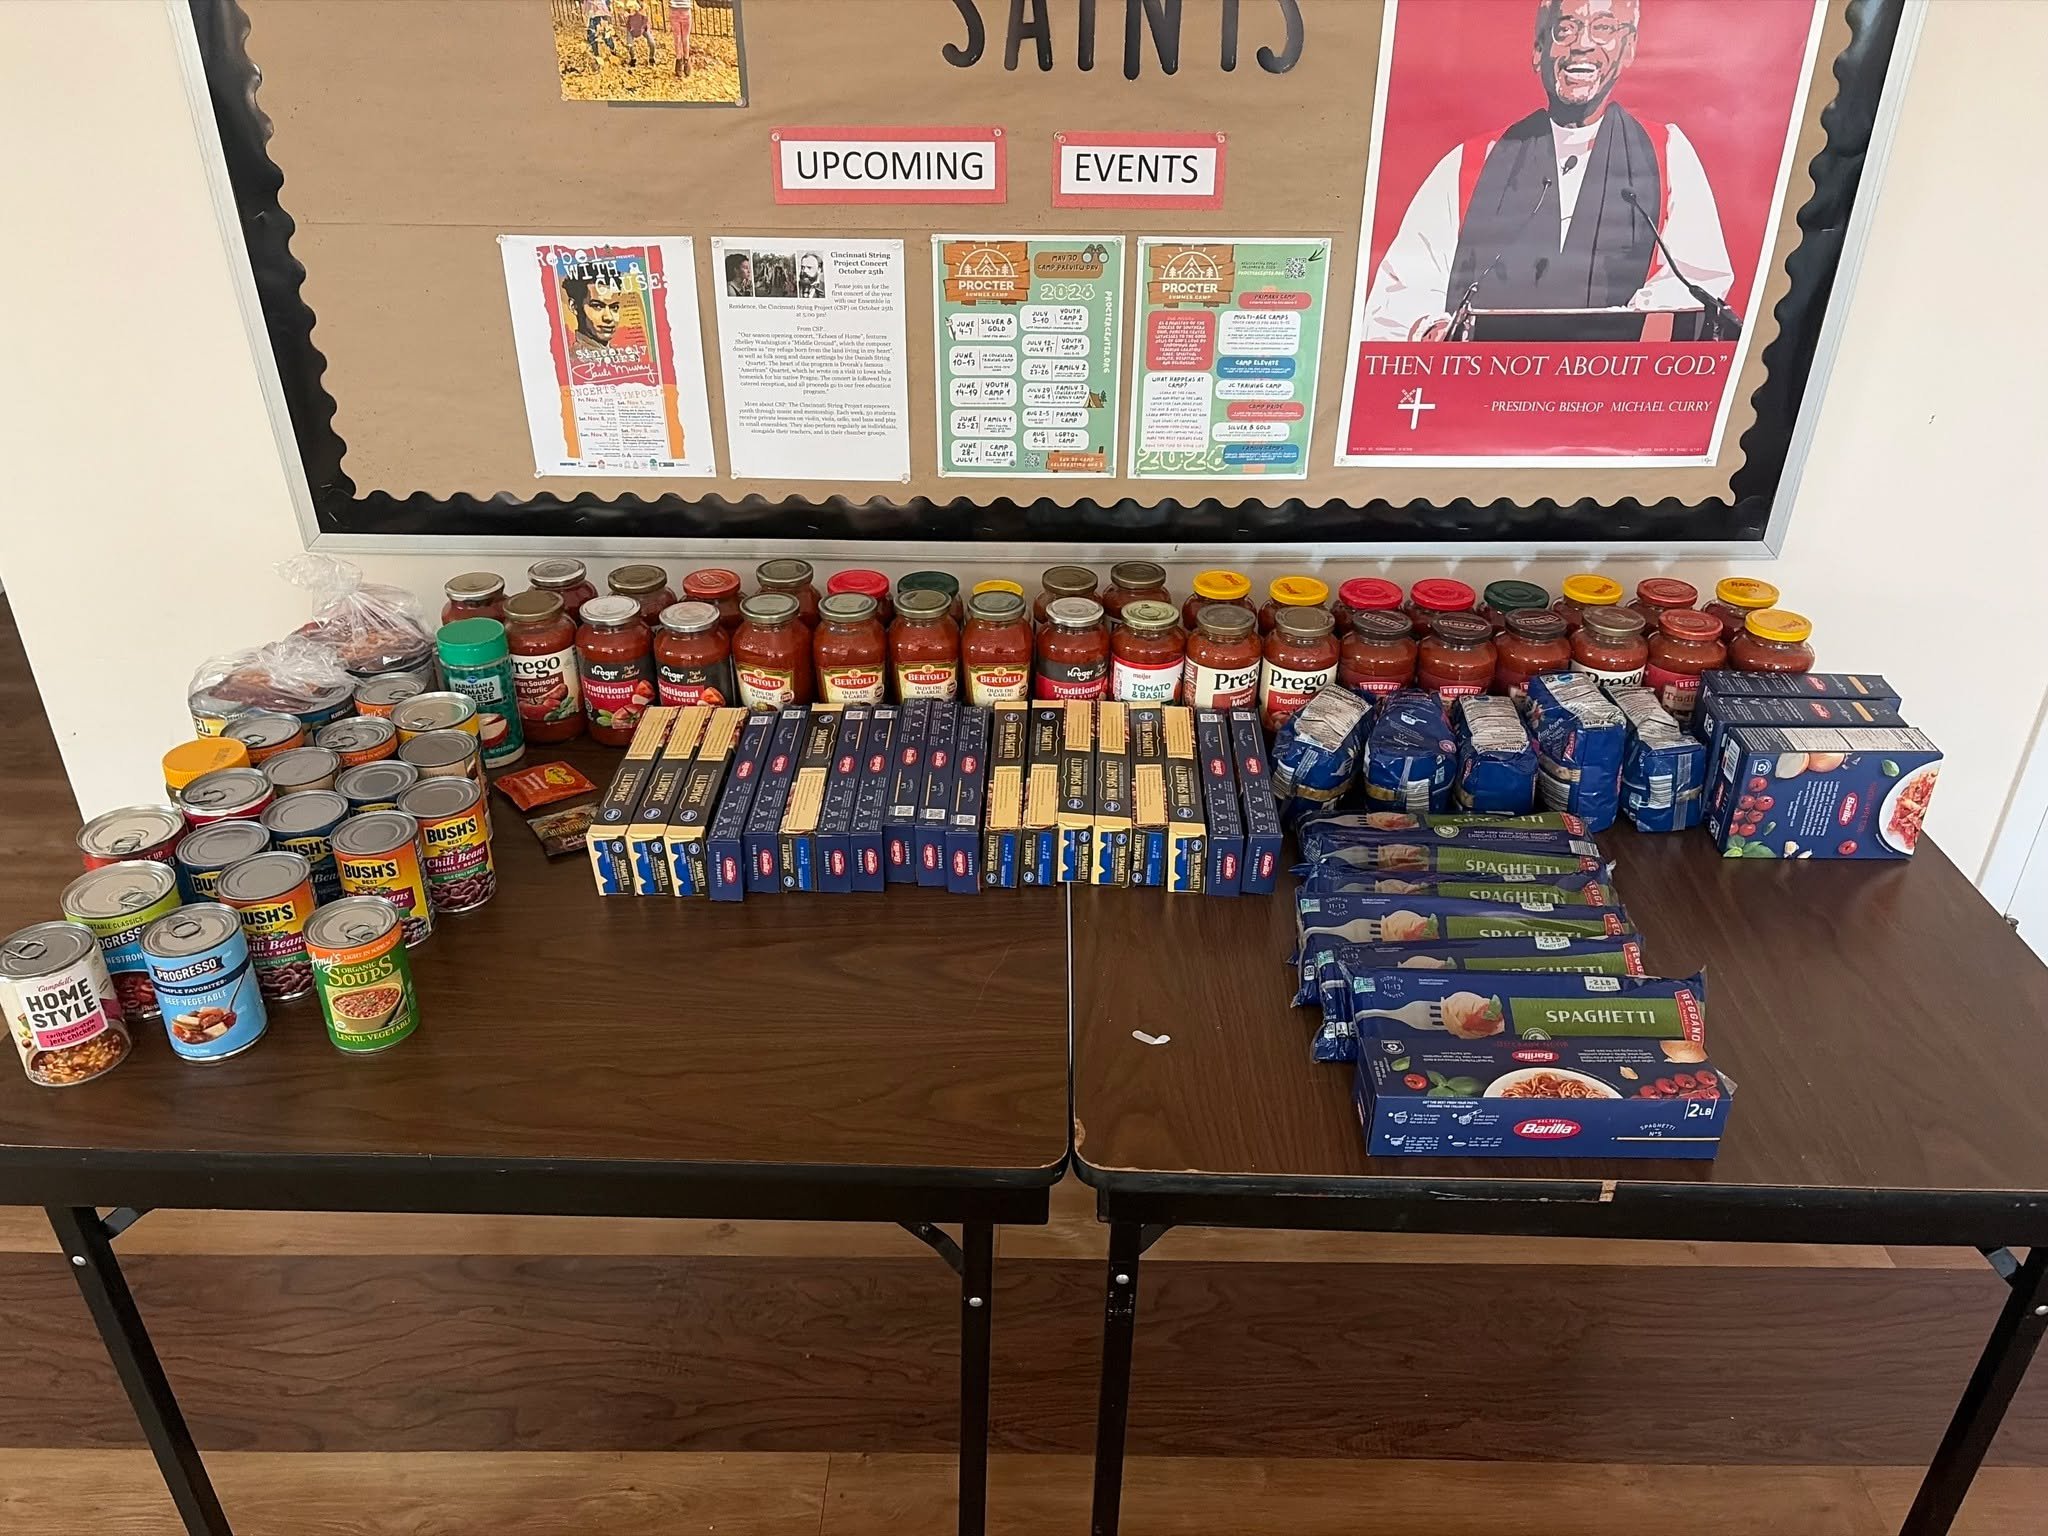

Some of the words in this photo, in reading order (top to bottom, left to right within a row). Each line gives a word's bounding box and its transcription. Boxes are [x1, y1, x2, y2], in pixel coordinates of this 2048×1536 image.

[797, 151, 984, 182] UPCOMING
[1075, 154, 1198, 184] EVENTS
[869, 252, 891, 260] String
[564, 260, 619, 281] WITH
[958, 280, 1014, 291] PROCTER
[1040, 284, 1095, 300] 2026
[1162, 282, 1218, 293] PROCTER
[956, 320, 975, 328] JUNE
[1103, 291, 1113, 373] PROCTERCENTER.ORG
[1365, 355, 1431, 376] THEN
[1441, 355, 1481, 376] IT'S
[1489, 355, 1550, 376] NOT
[1554, 355, 1648, 377] ABOUT
[562, 386, 617, 398] CONCERTS
[1491, 401, 1555, 413] PRESIDING
[1559, 401, 1604, 413] BISHOP
[1610, 401, 1665, 413] MICHAEL
[1668, 401, 1713, 413] CURRY
[511, 656, 560, 678] rego
[591, 665, 618, 681] Kroger
[661, 666, 685, 682] Kroger
[1067, 667, 1093, 681] Kroger
[528, 676, 559, 687] Sausage
[743, 674, 781, 687] BERTOLLI
[833, 676, 876, 688] BERTOLLI
[907, 671, 950, 683] BERTOLLI
[979, 674, 1022, 686] BERTOLLI
[1132, 672, 1151, 680] meijer
[1270, 668, 1327, 695] Prego
[526, 686, 548, 694] Garlic
[584, 681, 634, 694] Traditional
[1132, 682, 1171, 693] TOMATO
[1132, 691, 1139, 699] &
[1140, 691, 1164, 700] BASIL
[1443, 687, 1479, 695] REGGANO
[1070, 759, 1082, 784] SPAGHETTI
[1106, 761, 1117, 787] SPAGHETTI
[613, 773, 636, 802] SPAGHETTI
[652, 772, 674, 801] SPAGHETTI
[688, 774, 709, 803] SPAGHETTI
[1840, 797, 1856, 822] Barilla
[426, 818, 476, 845] BUSH'S
[427, 855, 454, 868] Chili
[458, 846, 485, 862] Beans
[436, 865, 460, 873] KIDNEY
[463, 857, 482, 867] BEANS
[343, 862, 397, 880] BUSH'S
[1466, 860, 1560, 874] SPAGHETTI
[113, 917, 144, 928] CLASSICS
[311, 951, 342, 972] Amy's
[341, 961, 376, 973] ORGANIC
[157, 959, 216, 982] PROGRESSO
[329, 955, 393, 986] SOUPS
[38, 976, 73, 992] Campbell's
[160, 986, 184, 994] SIMPLE
[184, 980, 225, 994] FAVORITES
[26, 978, 91, 1012] HOME
[164, 996, 180, 1005] BEEF
[181, 990, 227, 1006] VEGETABLE
[32, 995, 97, 1028] STYLE
[1546, 1010, 1656, 1024] SPAGHETTI
[1681, 993, 1701, 1042] REGGANO
[46, 1019, 95, 1039] caribbean-style
[50, 1035, 67, 1046] jerk
[68, 1023, 96, 1041] chicken
[336, 1031, 365, 1042] LENTIL
[367, 1017, 411, 1040] VEGETABLE
[1518, 1052, 1553, 1060] Barilla
[1521, 1122, 1573, 1135] Barilla
[1640, 1122, 1676, 1131] SPAGHETTI
